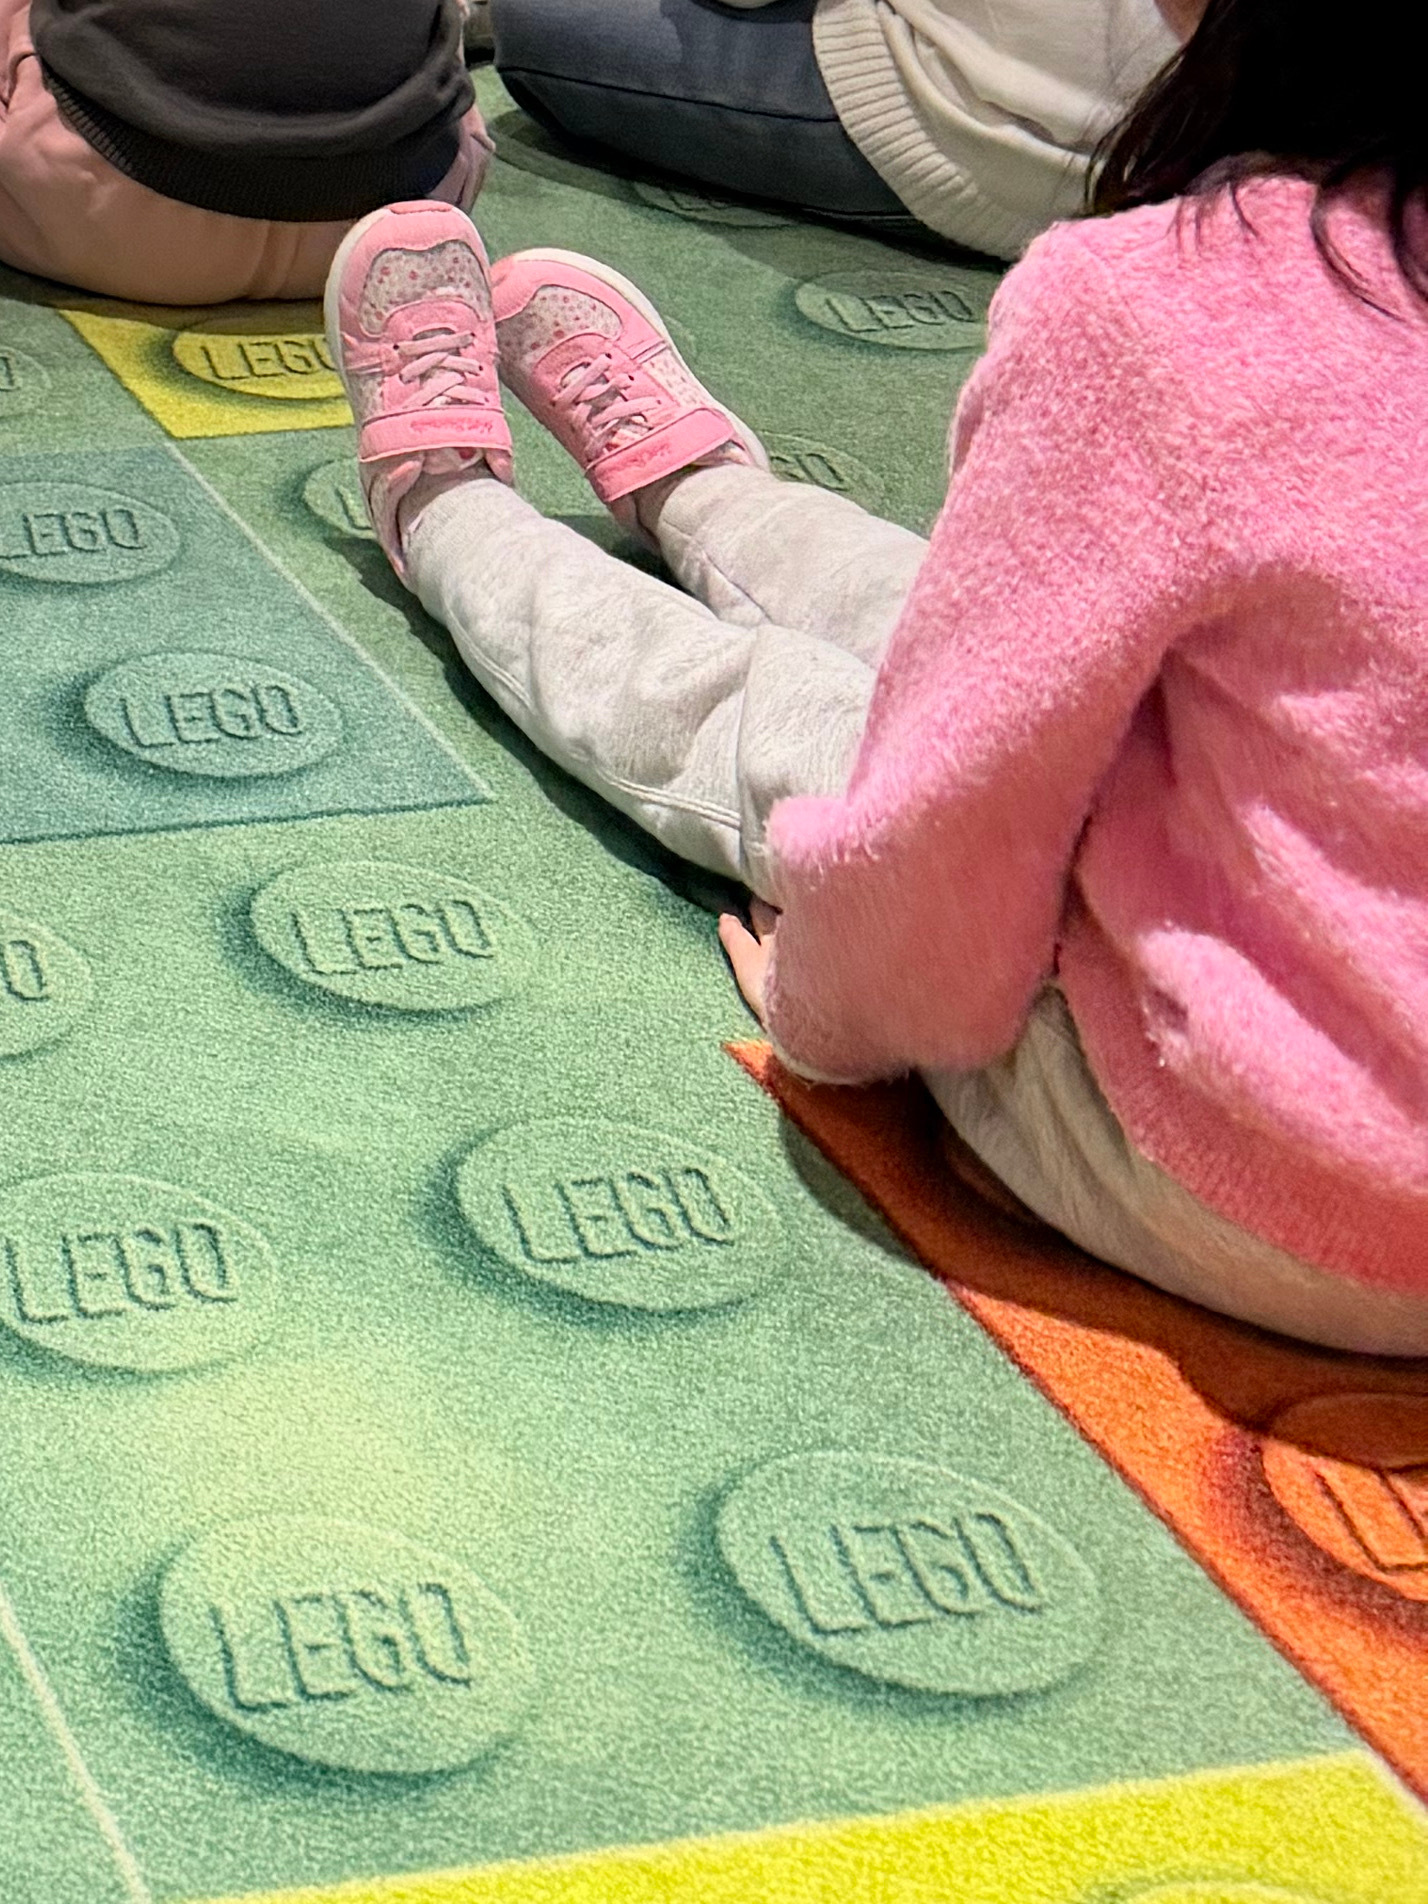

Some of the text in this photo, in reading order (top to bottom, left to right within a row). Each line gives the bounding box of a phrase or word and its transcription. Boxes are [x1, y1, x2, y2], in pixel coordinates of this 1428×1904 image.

[825, 290, 981, 334] LEGO
[117, 685, 309, 750] LEGO
[292, 899, 495, 977] LEGO
[501, 1168, 736, 1265] LEGO
[4, 1223, 240, 1326] LEGO
[768, 1512, 1047, 1637] LEGO
[209, 1581, 474, 1713] LEGO
